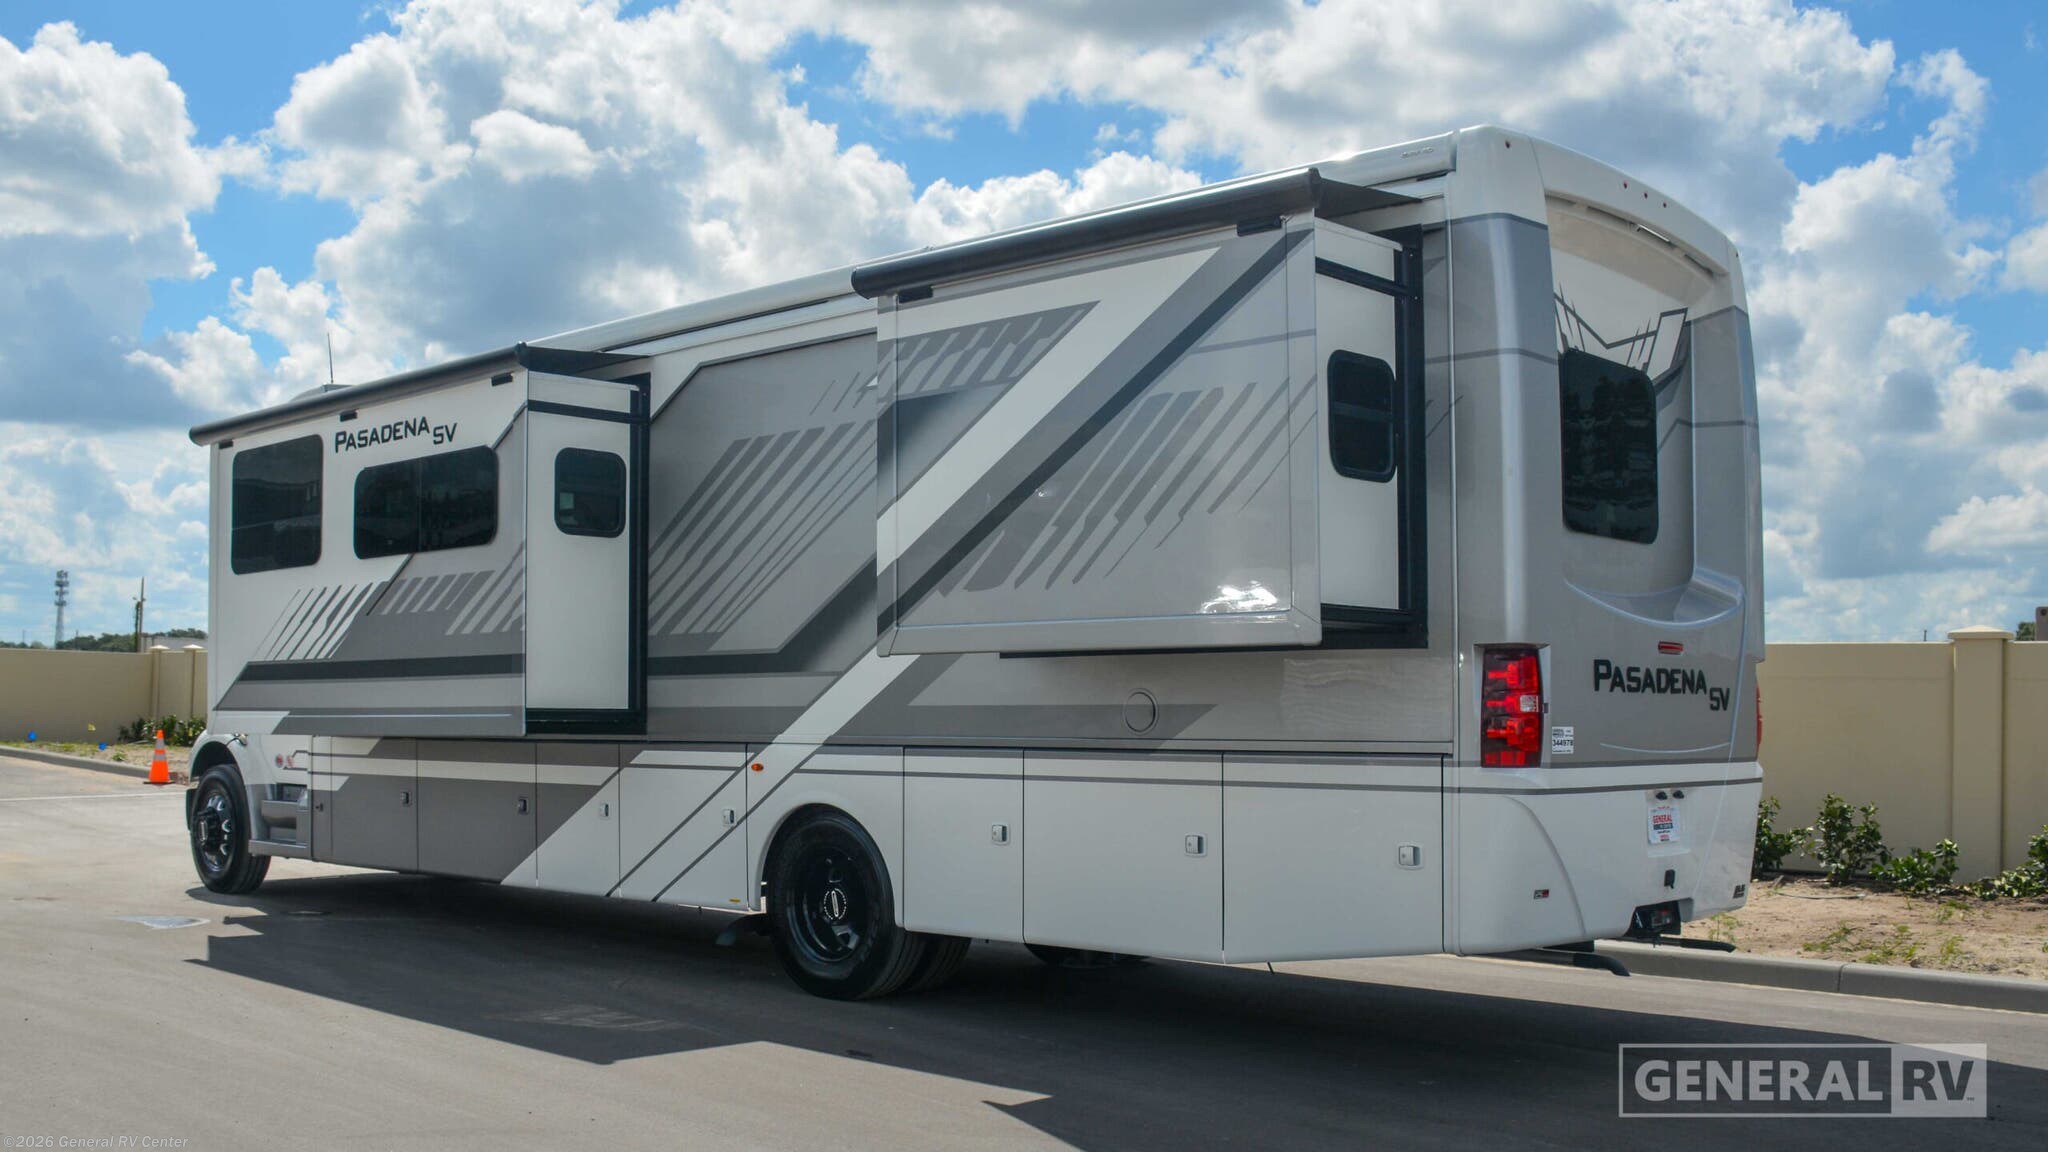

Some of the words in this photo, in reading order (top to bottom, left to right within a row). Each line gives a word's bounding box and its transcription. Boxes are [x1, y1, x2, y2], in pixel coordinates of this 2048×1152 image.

[335, 416, 430, 453] PASADENA
[433, 422, 458, 445] SV
[1593, 659, 1707, 695] PASADENA
[1709, 687, 1731, 711] SV
